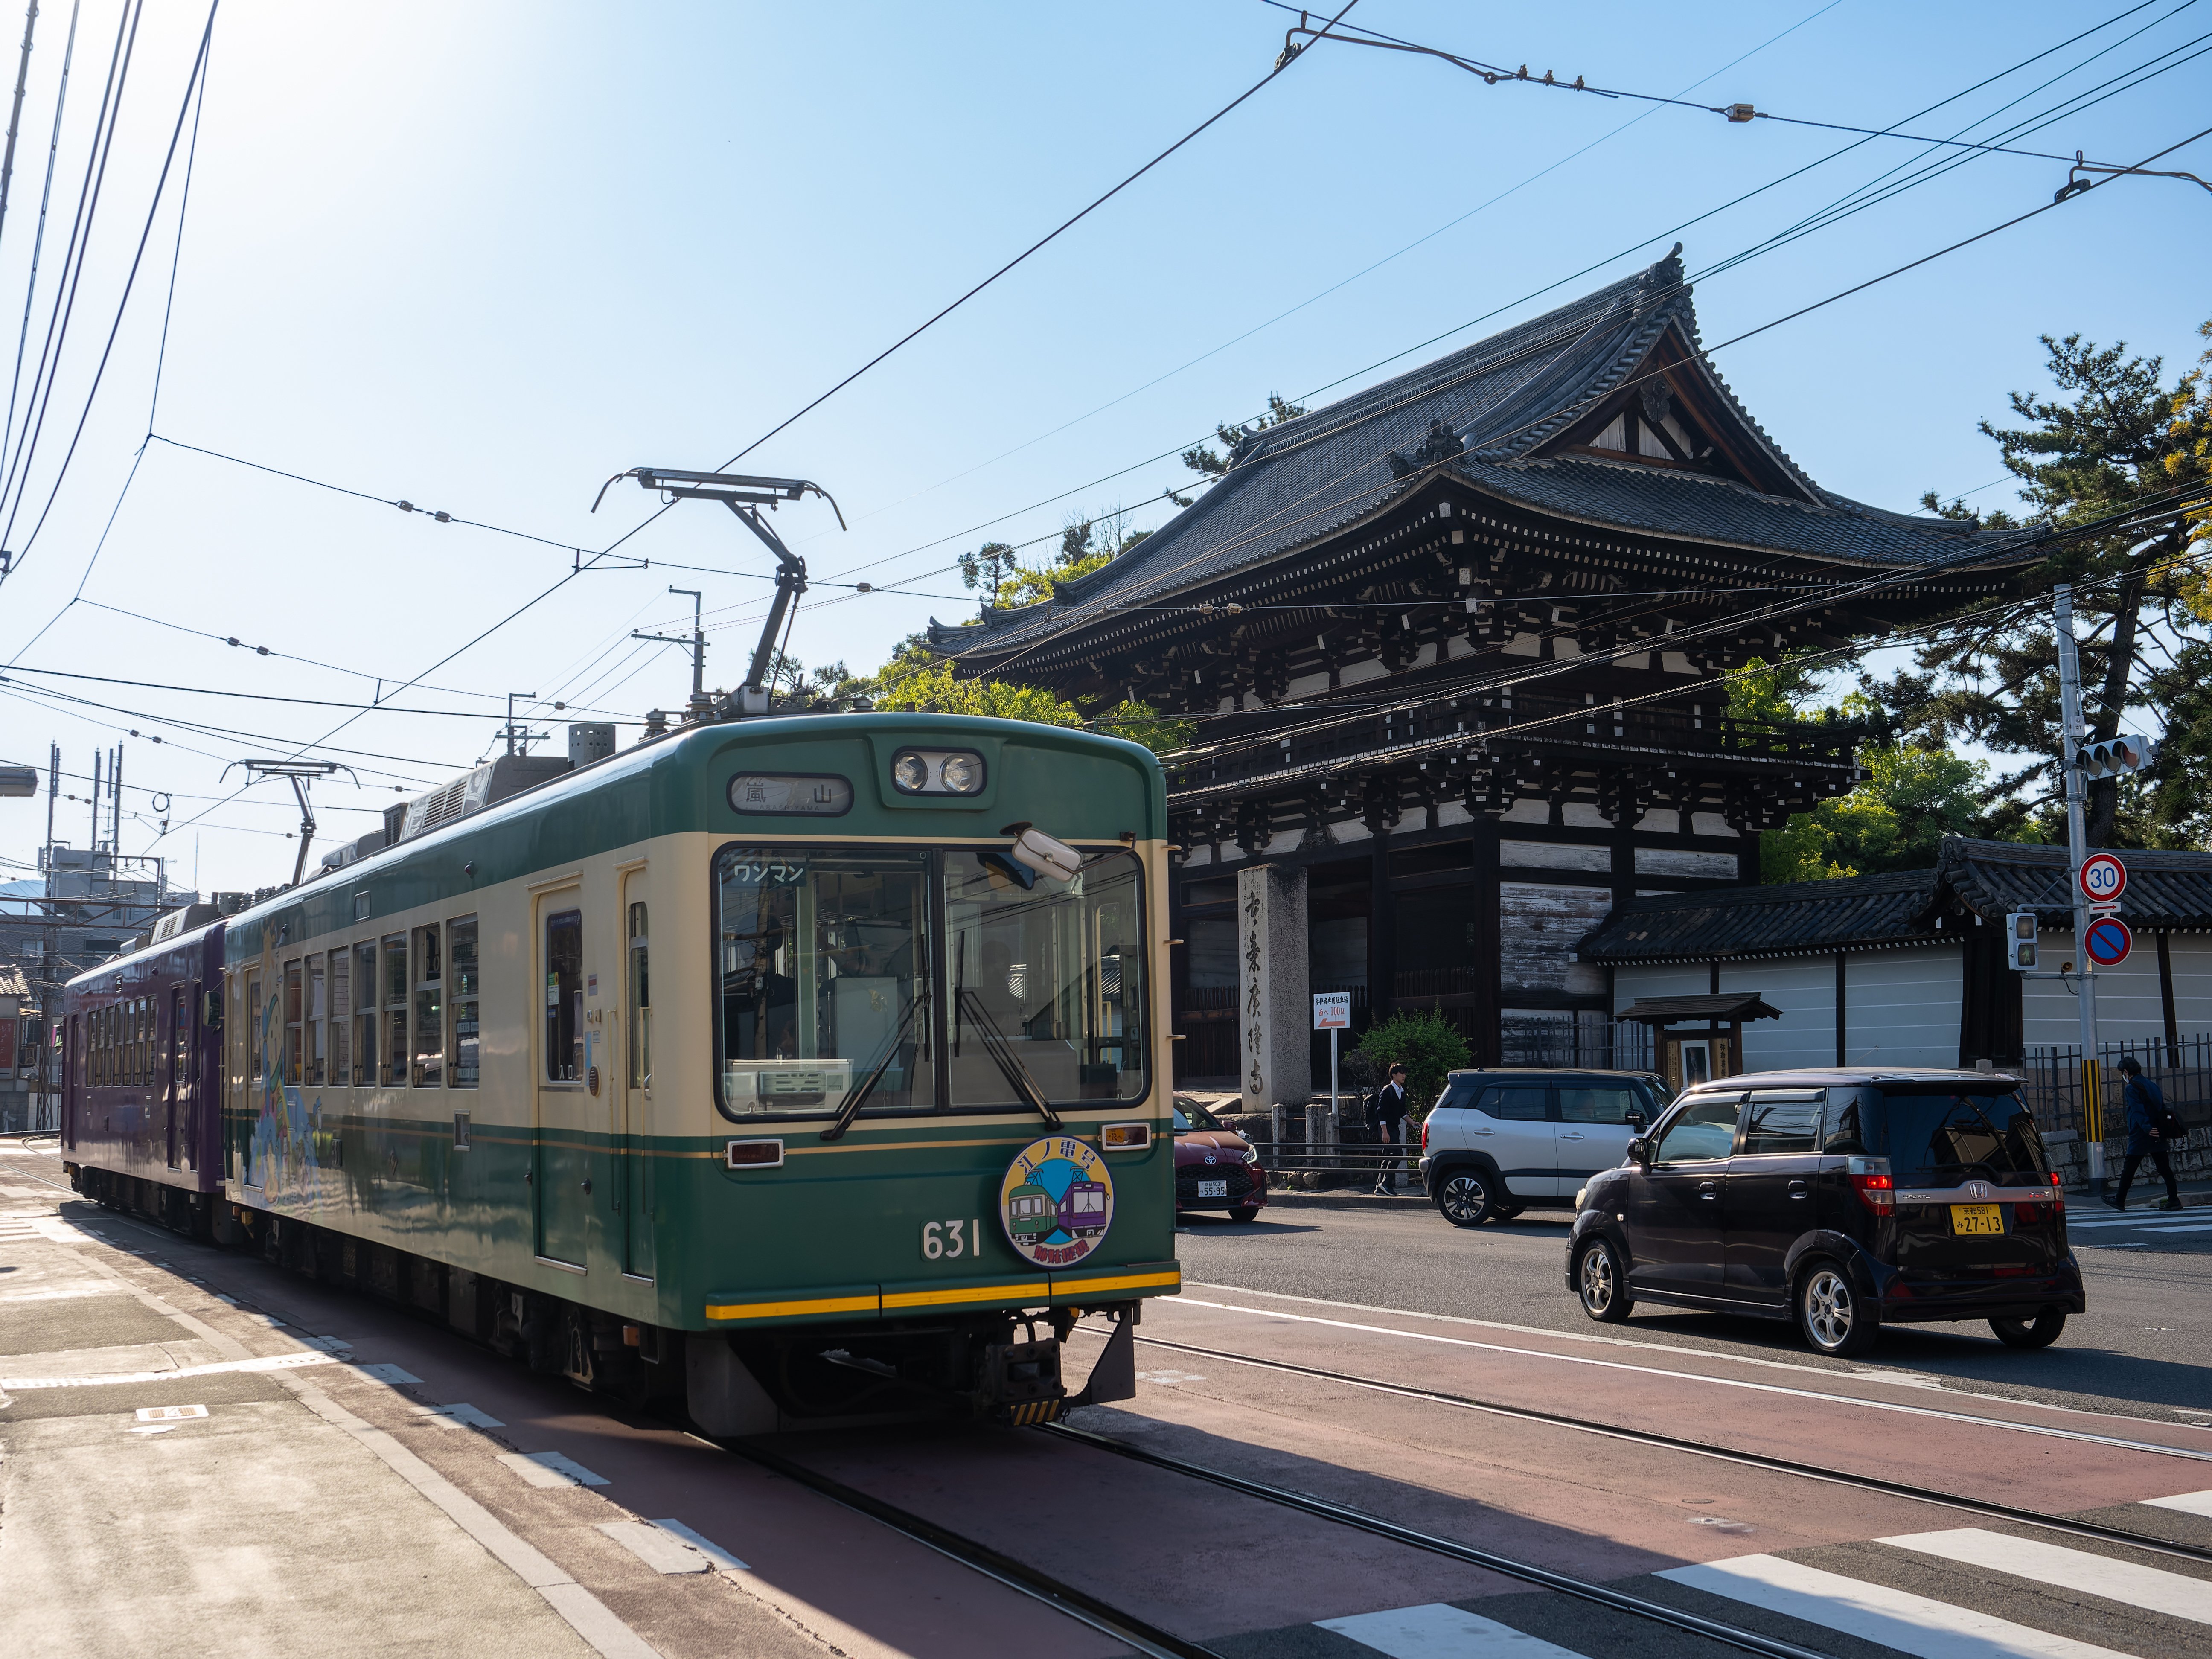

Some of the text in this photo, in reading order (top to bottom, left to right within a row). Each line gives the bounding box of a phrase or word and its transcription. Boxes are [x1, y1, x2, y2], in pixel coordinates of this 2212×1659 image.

[733, 865, 804, 884] ワンマン
[2090, 867, 2116, 889] 30
[1316, 995, 1348, 1006] 参拝者専用駐車場
[1318, 1008, 1329, 1016] 西へ
[1016, 1139, 1096, 1176] 江ノ電号
[1204, 1187, 1225, 1196] 55-95
[1963, 1206, 1989, 1215] 京都581
[1964, 1216, 2001, 1232] 27-13
[923, 1218, 981, 1259] 631
